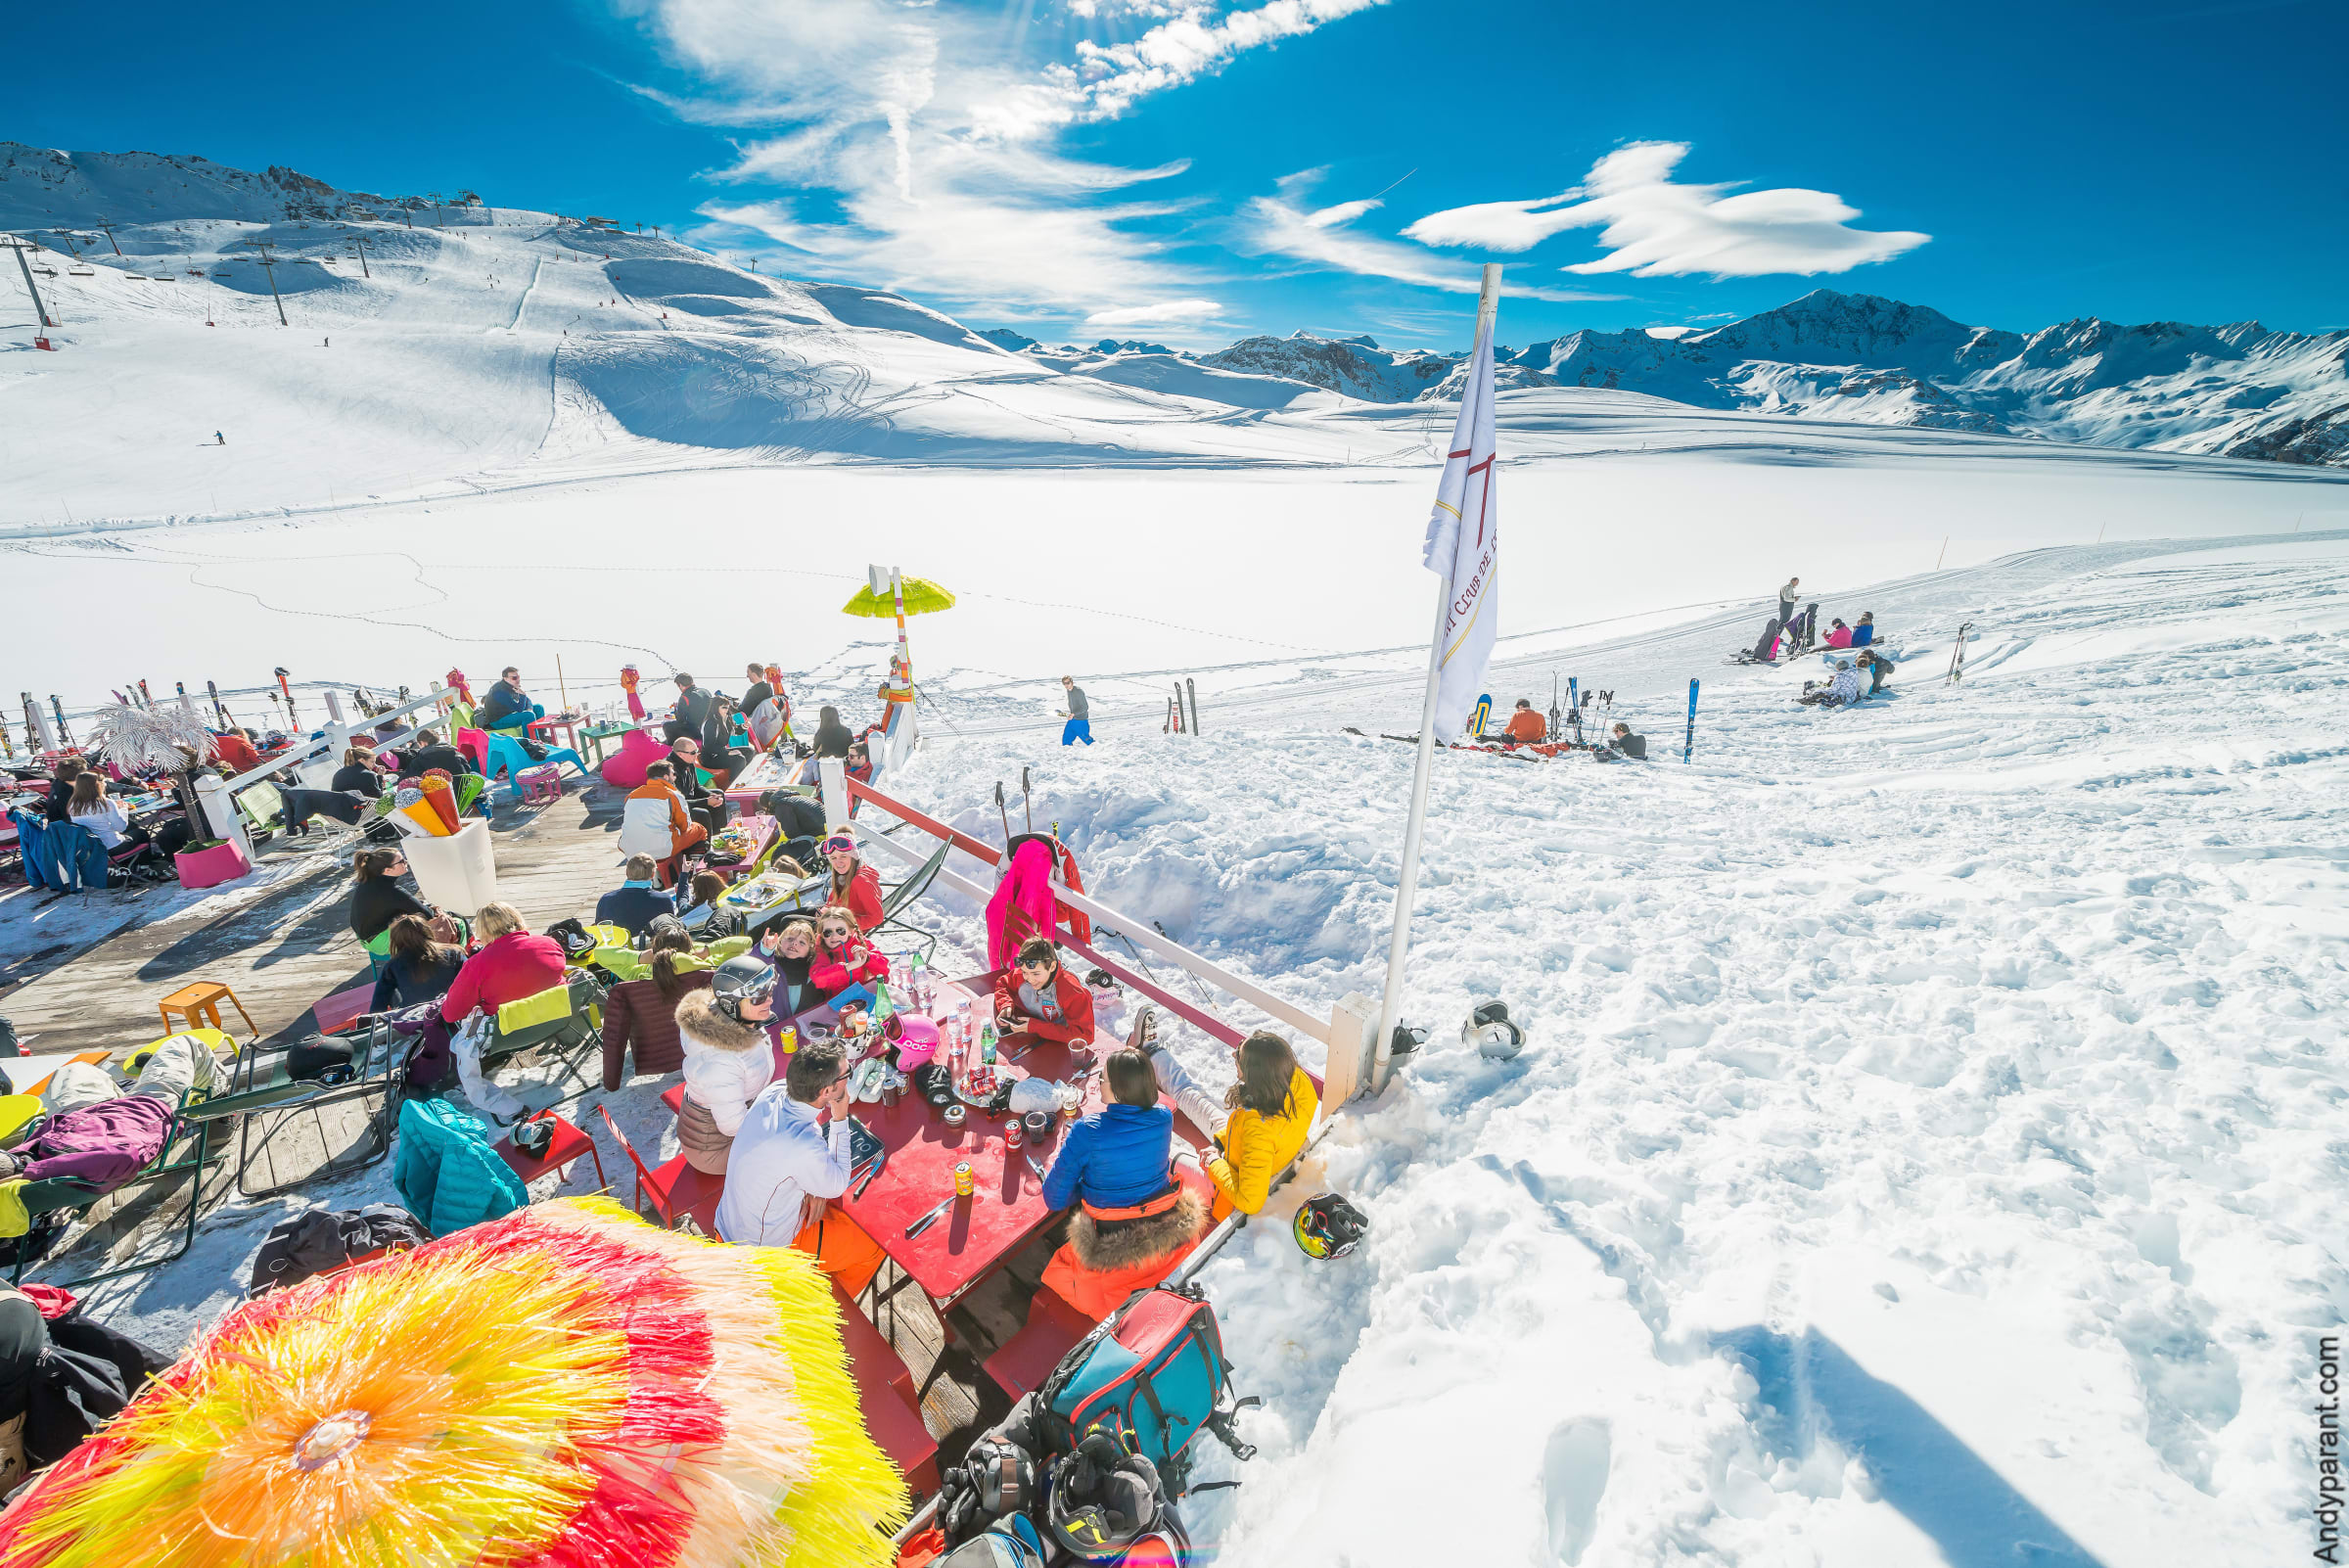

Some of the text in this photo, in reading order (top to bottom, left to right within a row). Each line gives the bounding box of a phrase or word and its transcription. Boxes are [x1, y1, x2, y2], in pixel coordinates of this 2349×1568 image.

[1454, 575, 1481, 616] CLUB
[1478, 550, 1492, 577] DE
[1086, 1311, 1116, 1341] ABS
